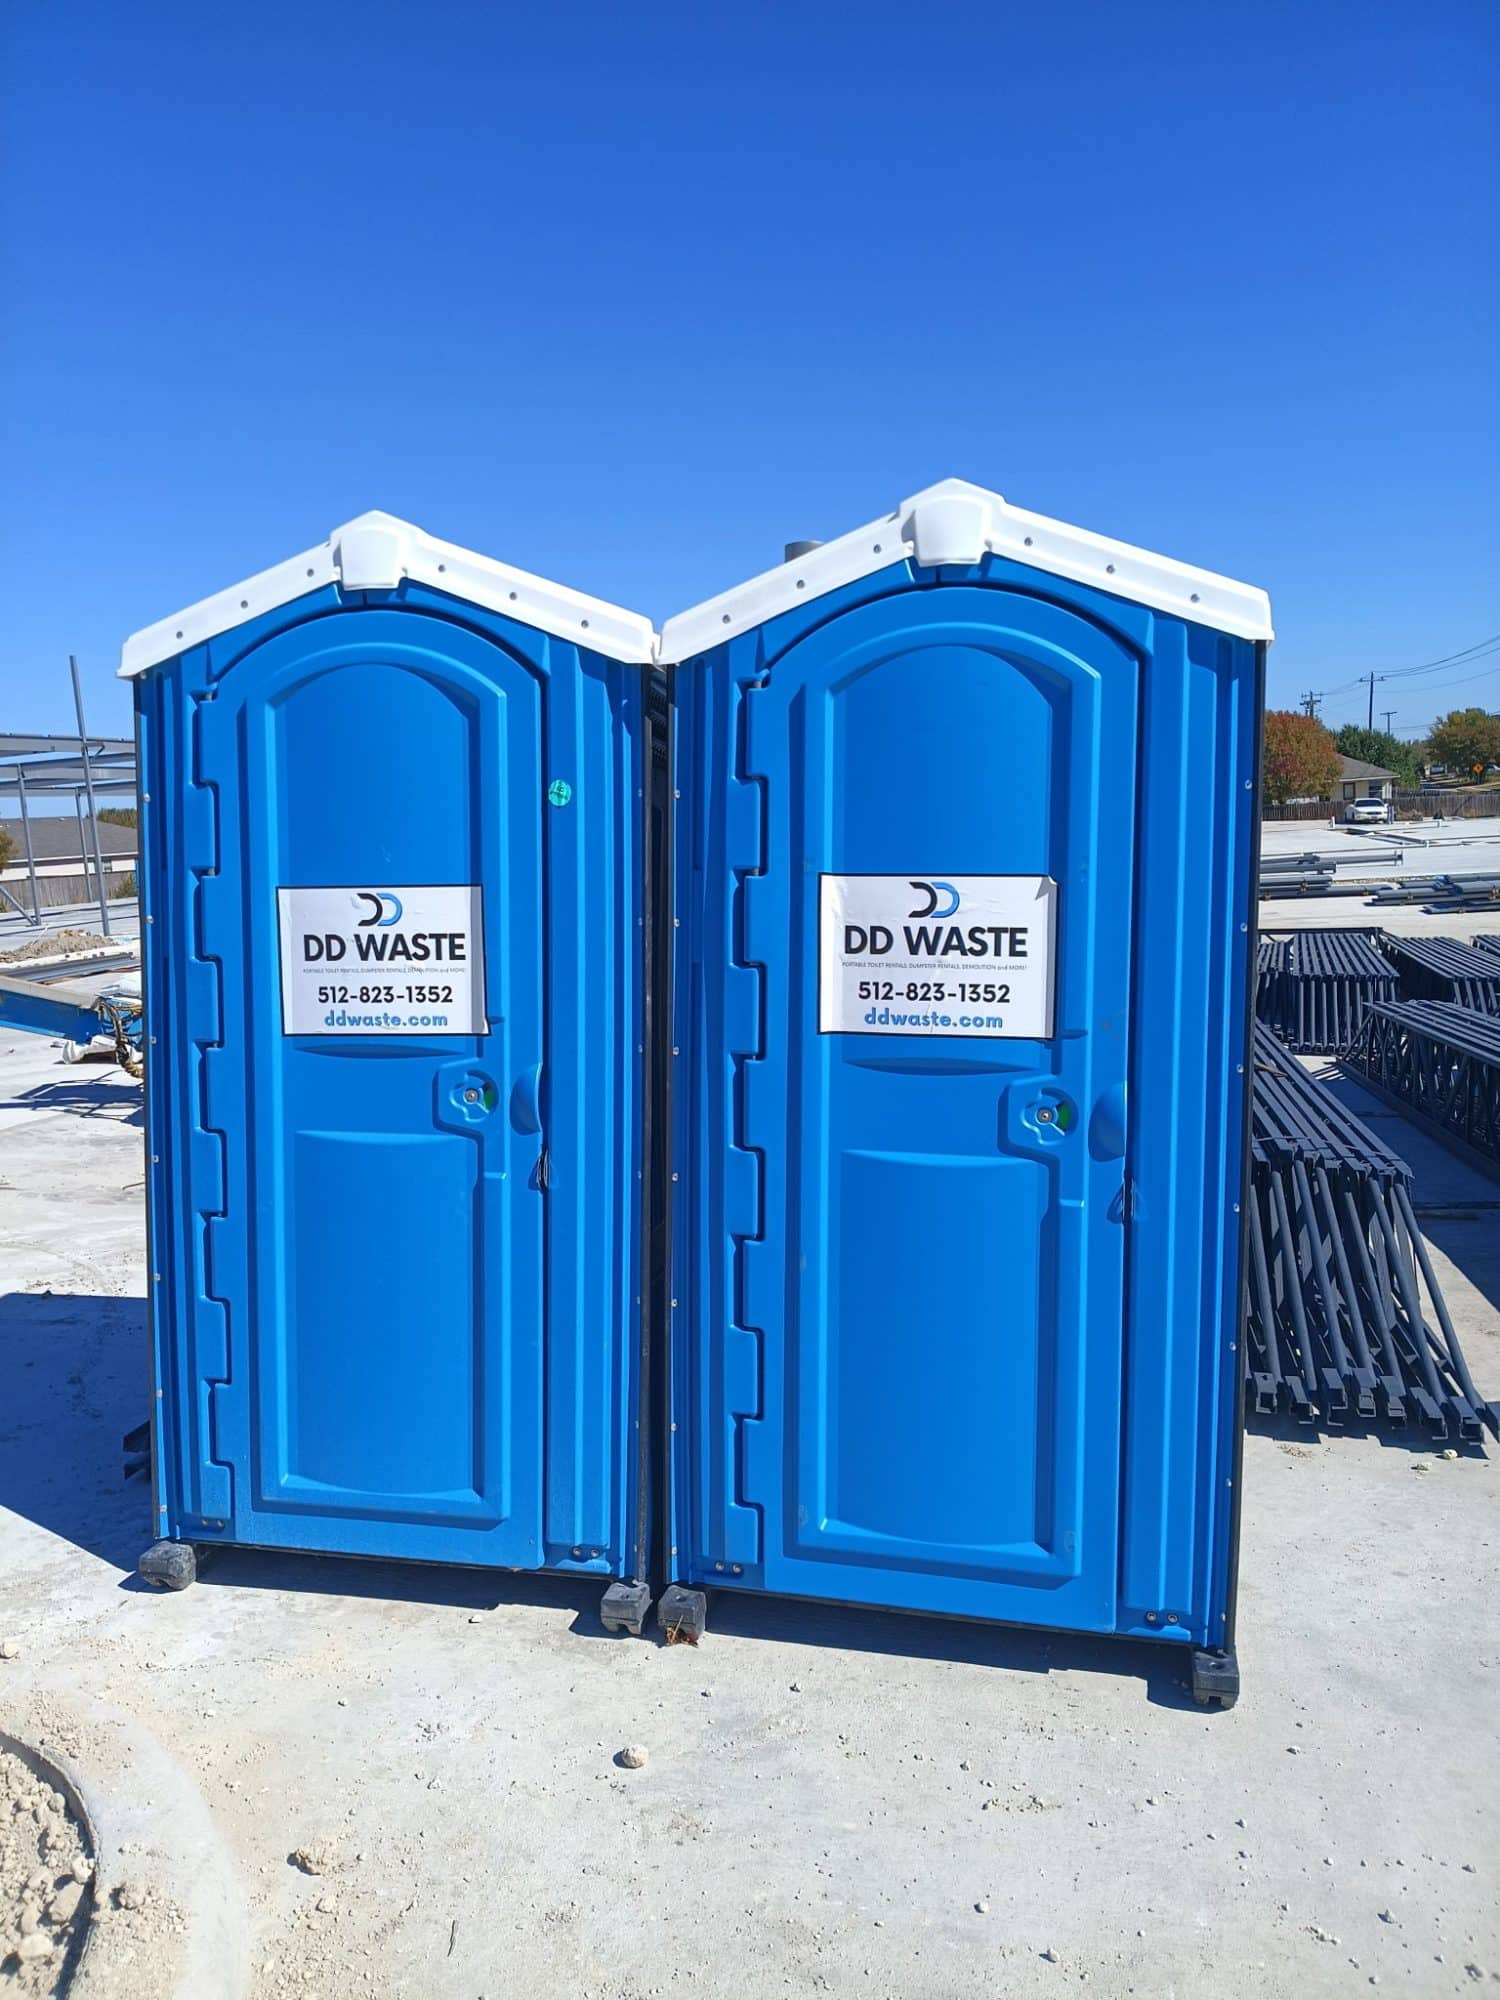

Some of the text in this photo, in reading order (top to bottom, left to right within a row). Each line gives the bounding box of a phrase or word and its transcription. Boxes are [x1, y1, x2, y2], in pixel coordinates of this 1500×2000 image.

[303, 933, 466, 962] DD WASTE
[844, 925, 1028, 958] DD WASTE
[318, 986, 453, 1004] 512-823-1352
[858, 981, 1011, 1004] 512-823-1352
[324, 1009, 448, 1027] ddwaste.com
[864, 1007, 1003, 1028] ddwaste.com
